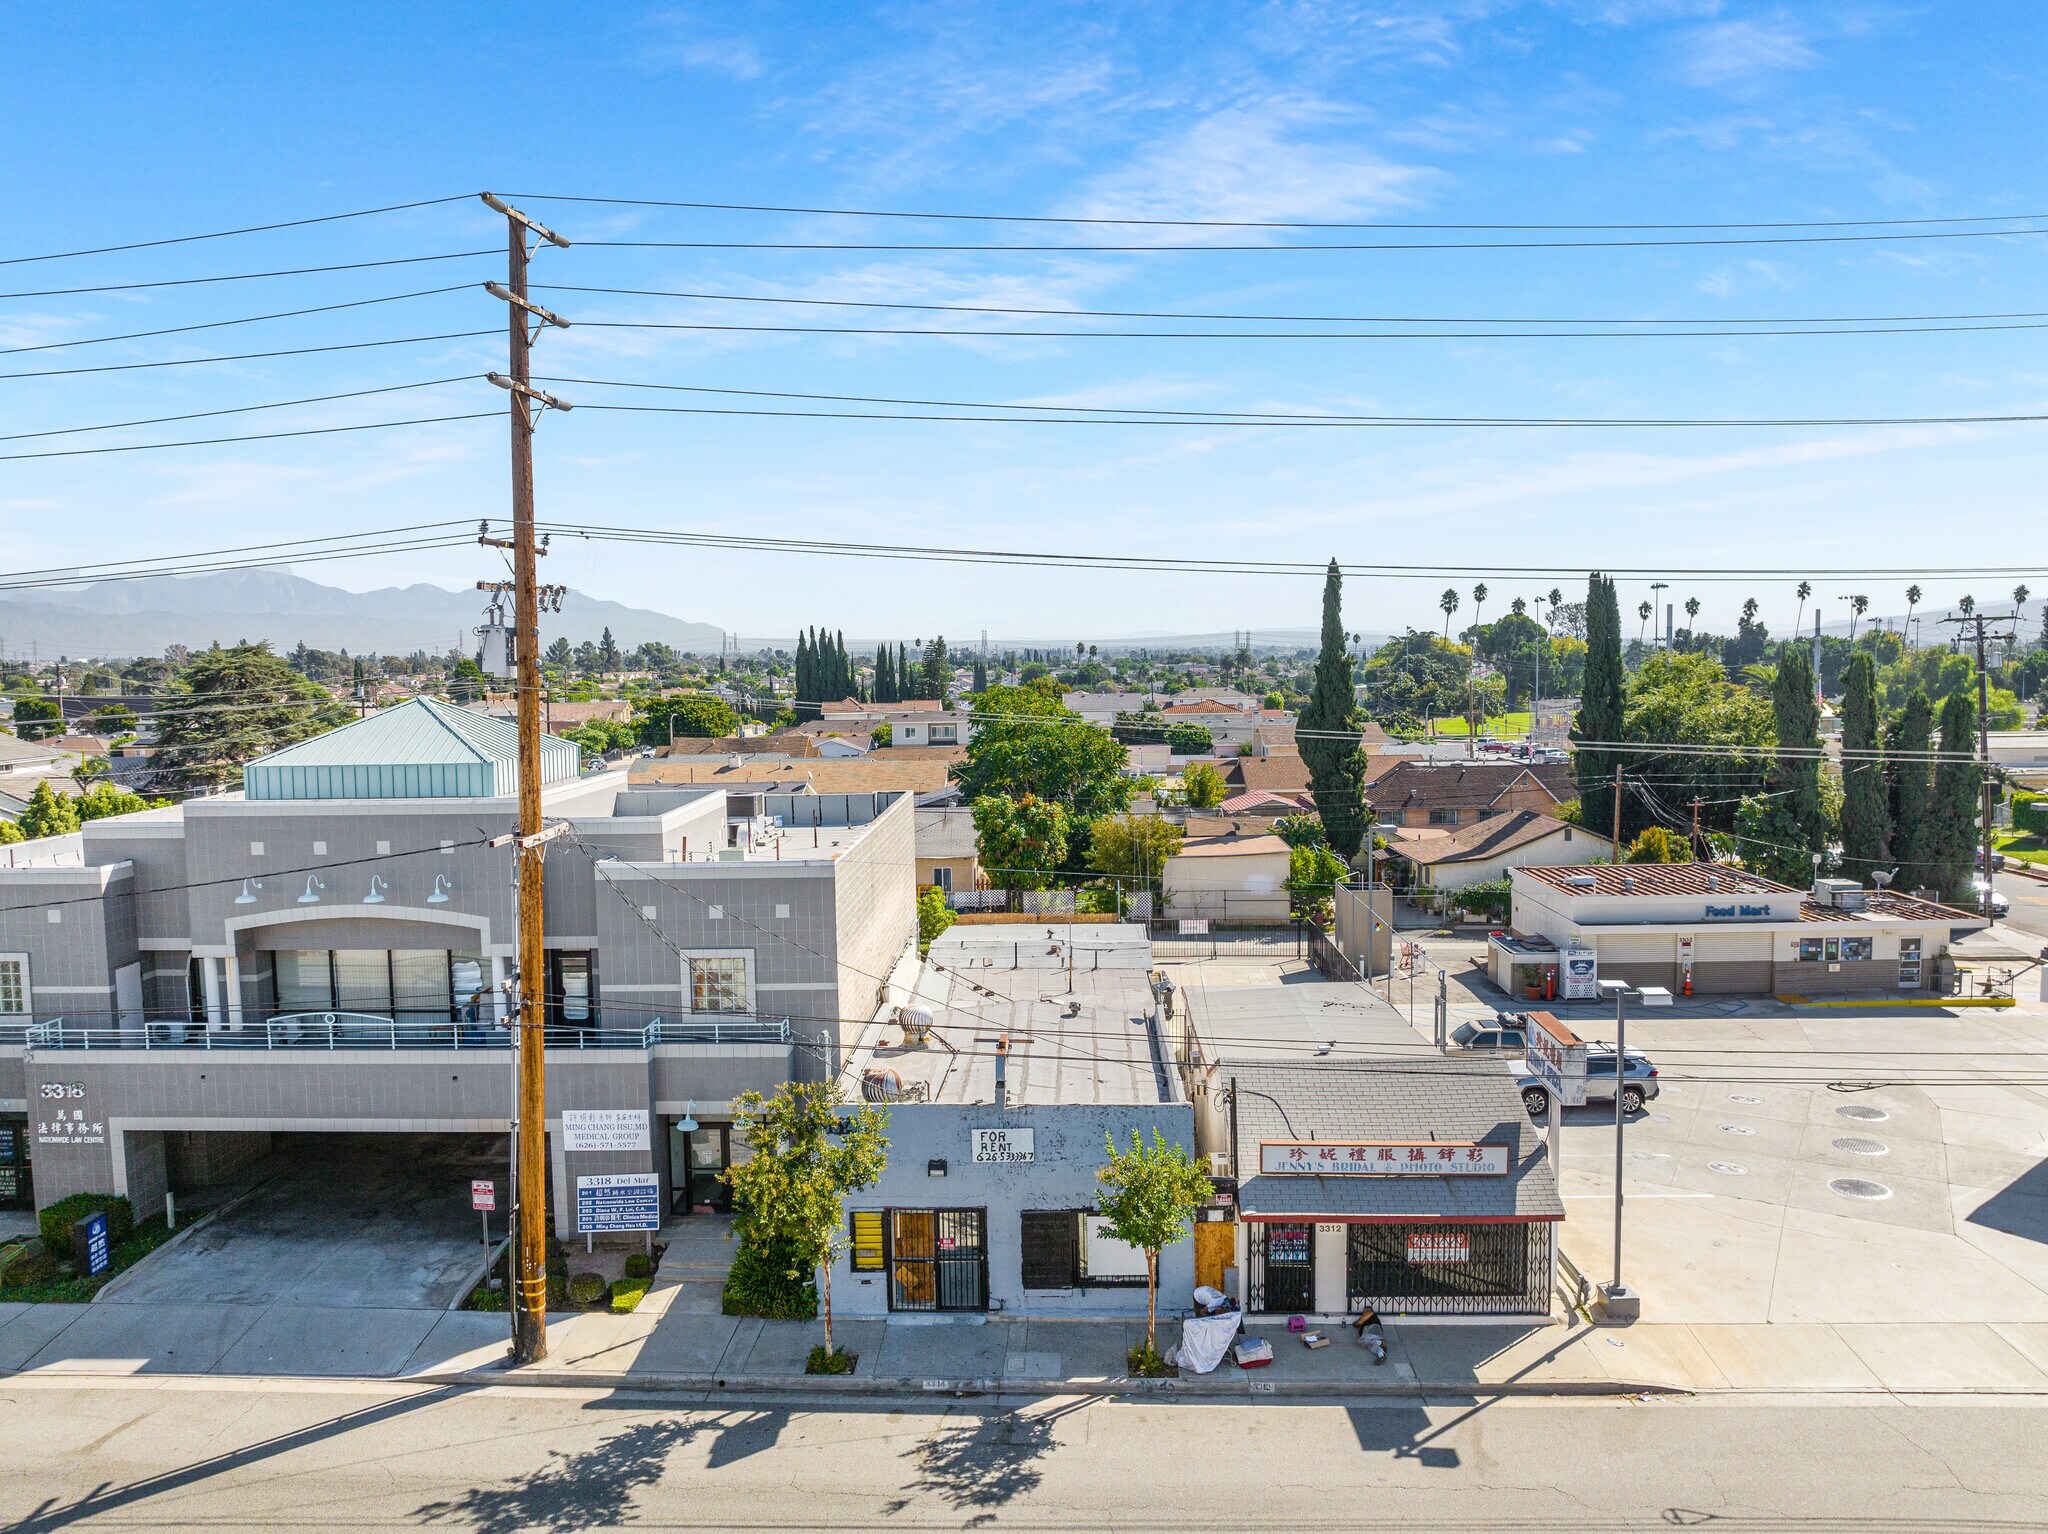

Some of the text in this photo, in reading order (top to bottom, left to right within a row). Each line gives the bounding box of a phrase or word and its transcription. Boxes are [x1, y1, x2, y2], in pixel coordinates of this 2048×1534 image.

[1705, 904, 1770, 917] Food Mart
[40, 1082, 86, 1099] 3318
[38, 1122, 103, 1135] 法律事務所
[565, 1123, 587, 1131] MING
[587, 1123, 615, 1131] CHANG
[574, 1132, 640, 1140] MEDICAL GROUP
[980, 1131, 1006, 1142] FOR
[980, 1142, 1012, 1152] RENT
[1274, 1161, 1496, 1173] JENNY'S BRIDAL & PHOTO STUDIO
[586, 1177, 612, 1186] 3318
[616, 1177, 631, 1185] Del
[1318, 1225, 1342, 1233] 3312
